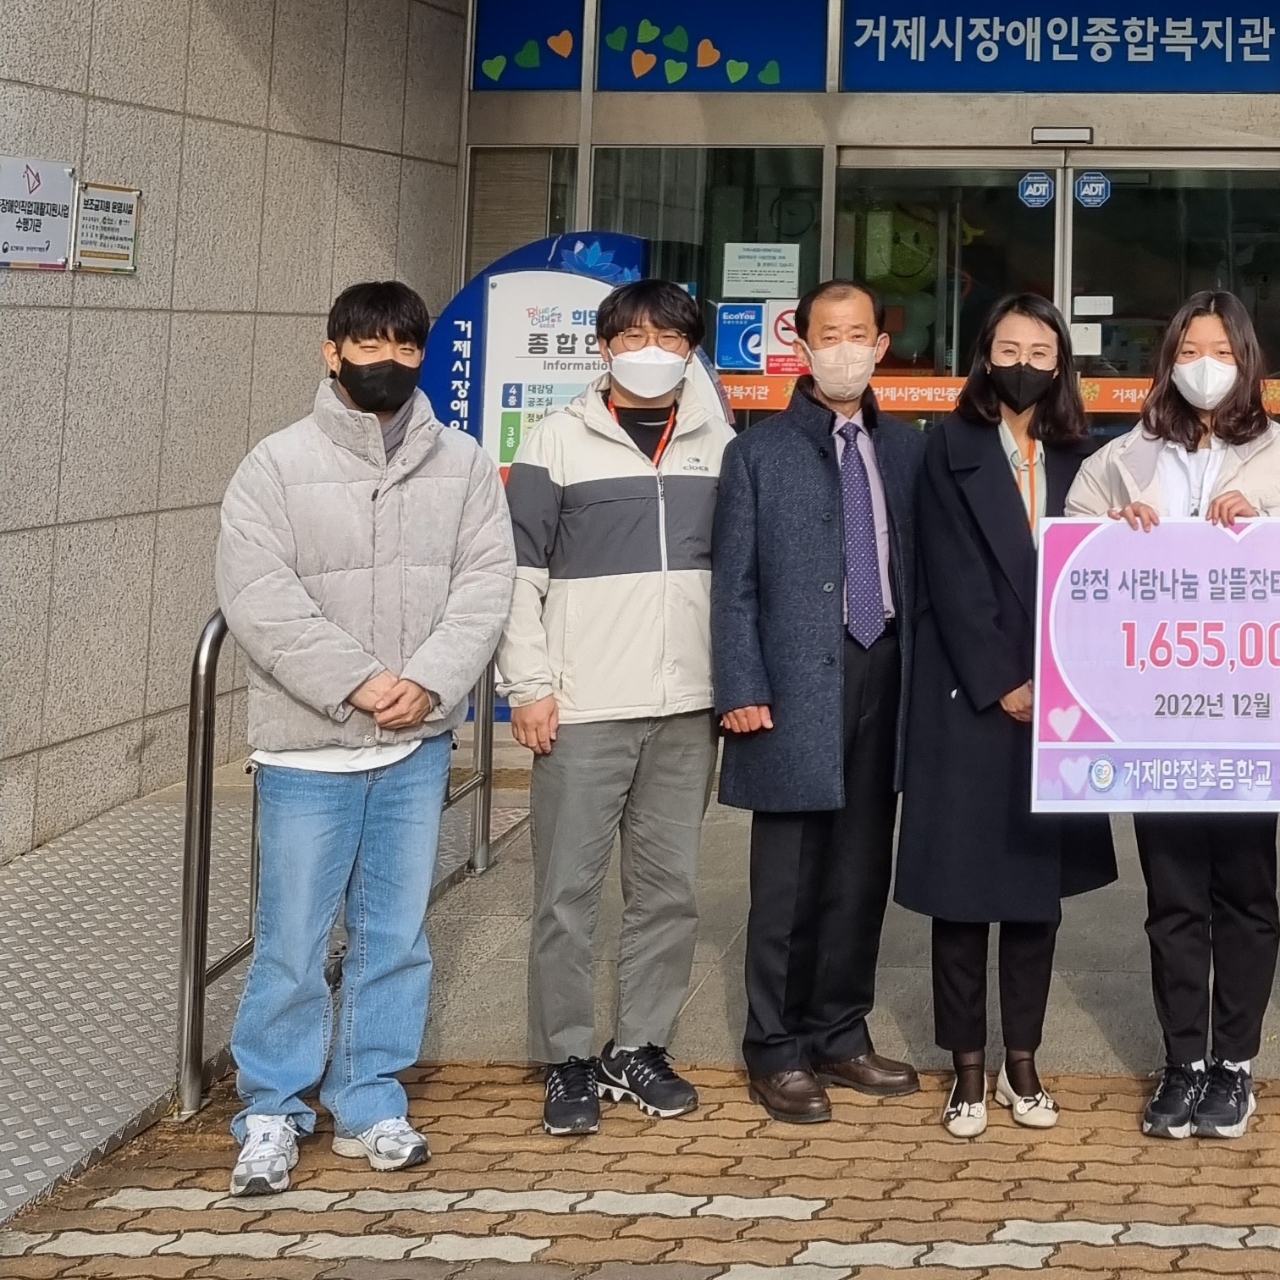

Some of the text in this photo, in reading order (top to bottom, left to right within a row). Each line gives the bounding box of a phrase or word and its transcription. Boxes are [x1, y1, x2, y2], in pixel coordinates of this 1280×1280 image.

[853, 16, 1276, 63] 거제시장애인종합복지관
[1024, 183, 1049, 196] ADT
[1080, 183, 1105, 196] ADT
[0, 199, 69, 218] 장애인직업재활지원사업
[15, 217, 43, 233] 수행기관
[722, 312, 756, 320] EcoYou
[527, 384, 554, 394] 대강당
[874, 386, 963, 402] 거제시장애인종
[1069, 567, 1111, 601] 양정
[1117, 568, 1200, 601] 사랑나눔
[1154, 693, 1225, 718] 2022년
[1231, 693, 1271, 718] 12월
[1122, 758, 1273, 791] 거제양정초등학교
